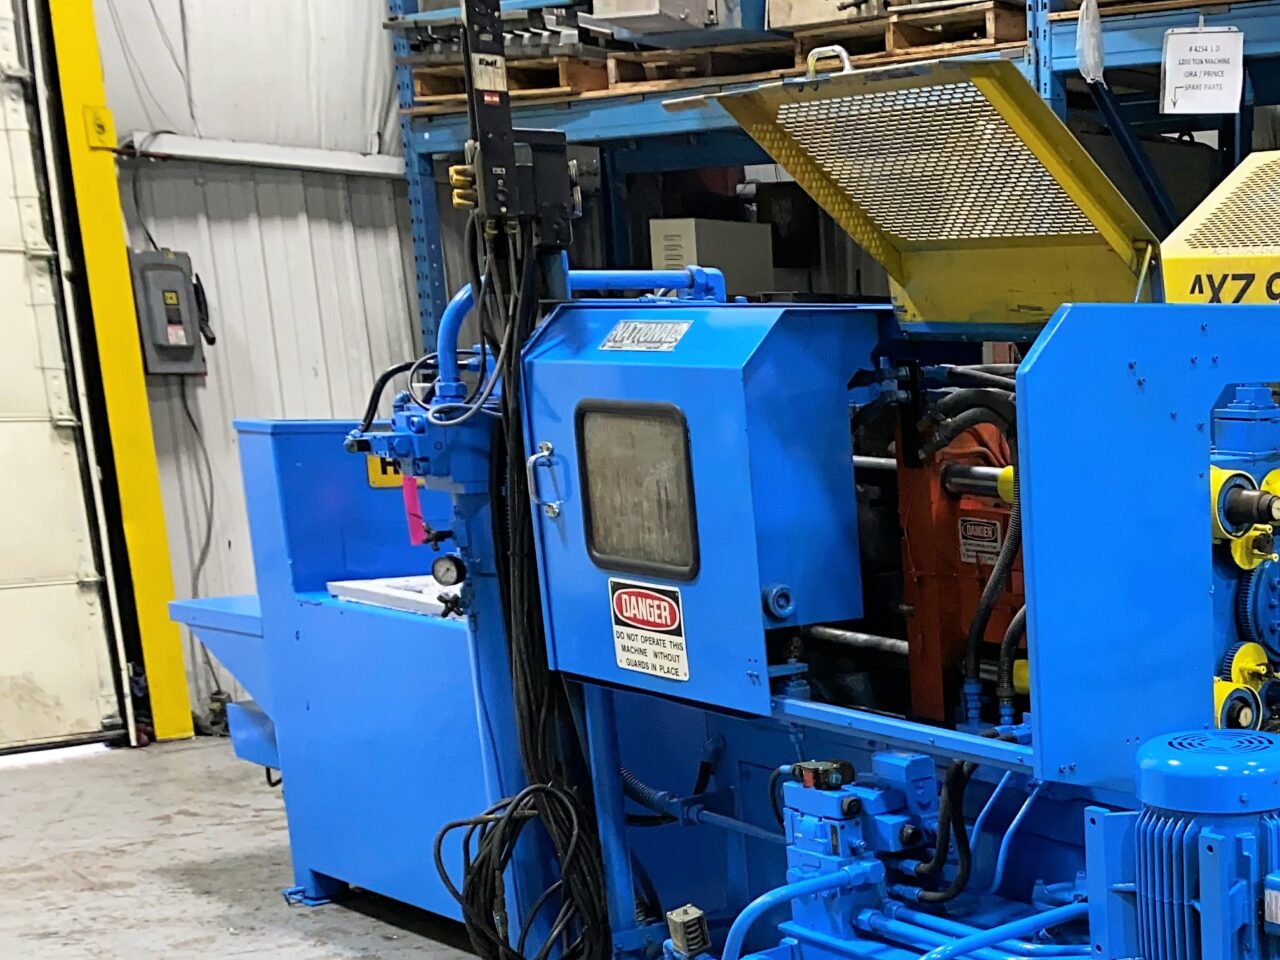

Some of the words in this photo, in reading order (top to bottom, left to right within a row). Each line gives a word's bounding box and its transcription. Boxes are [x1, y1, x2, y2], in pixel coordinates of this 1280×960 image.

[1204, 57, 1231, 65] MACHINE
[1203, 70, 1225, 78] PRINCE
[966, 524, 993, 538] DANGER
[621, 594, 671, 625] DANGER
[616, 630, 625, 640] DO
[626, 632, 638, 642] NOT
[640, 635, 667, 648] OPERATE
[669, 640, 684, 651] THIS
[621, 644, 648, 657] MACHINE
[653, 650, 680, 664] WITHOUT
[626, 658, 650, 670] GUARDS
[651, 663, 657, 672] IN
[659, 665, 680, 677] PLACE
